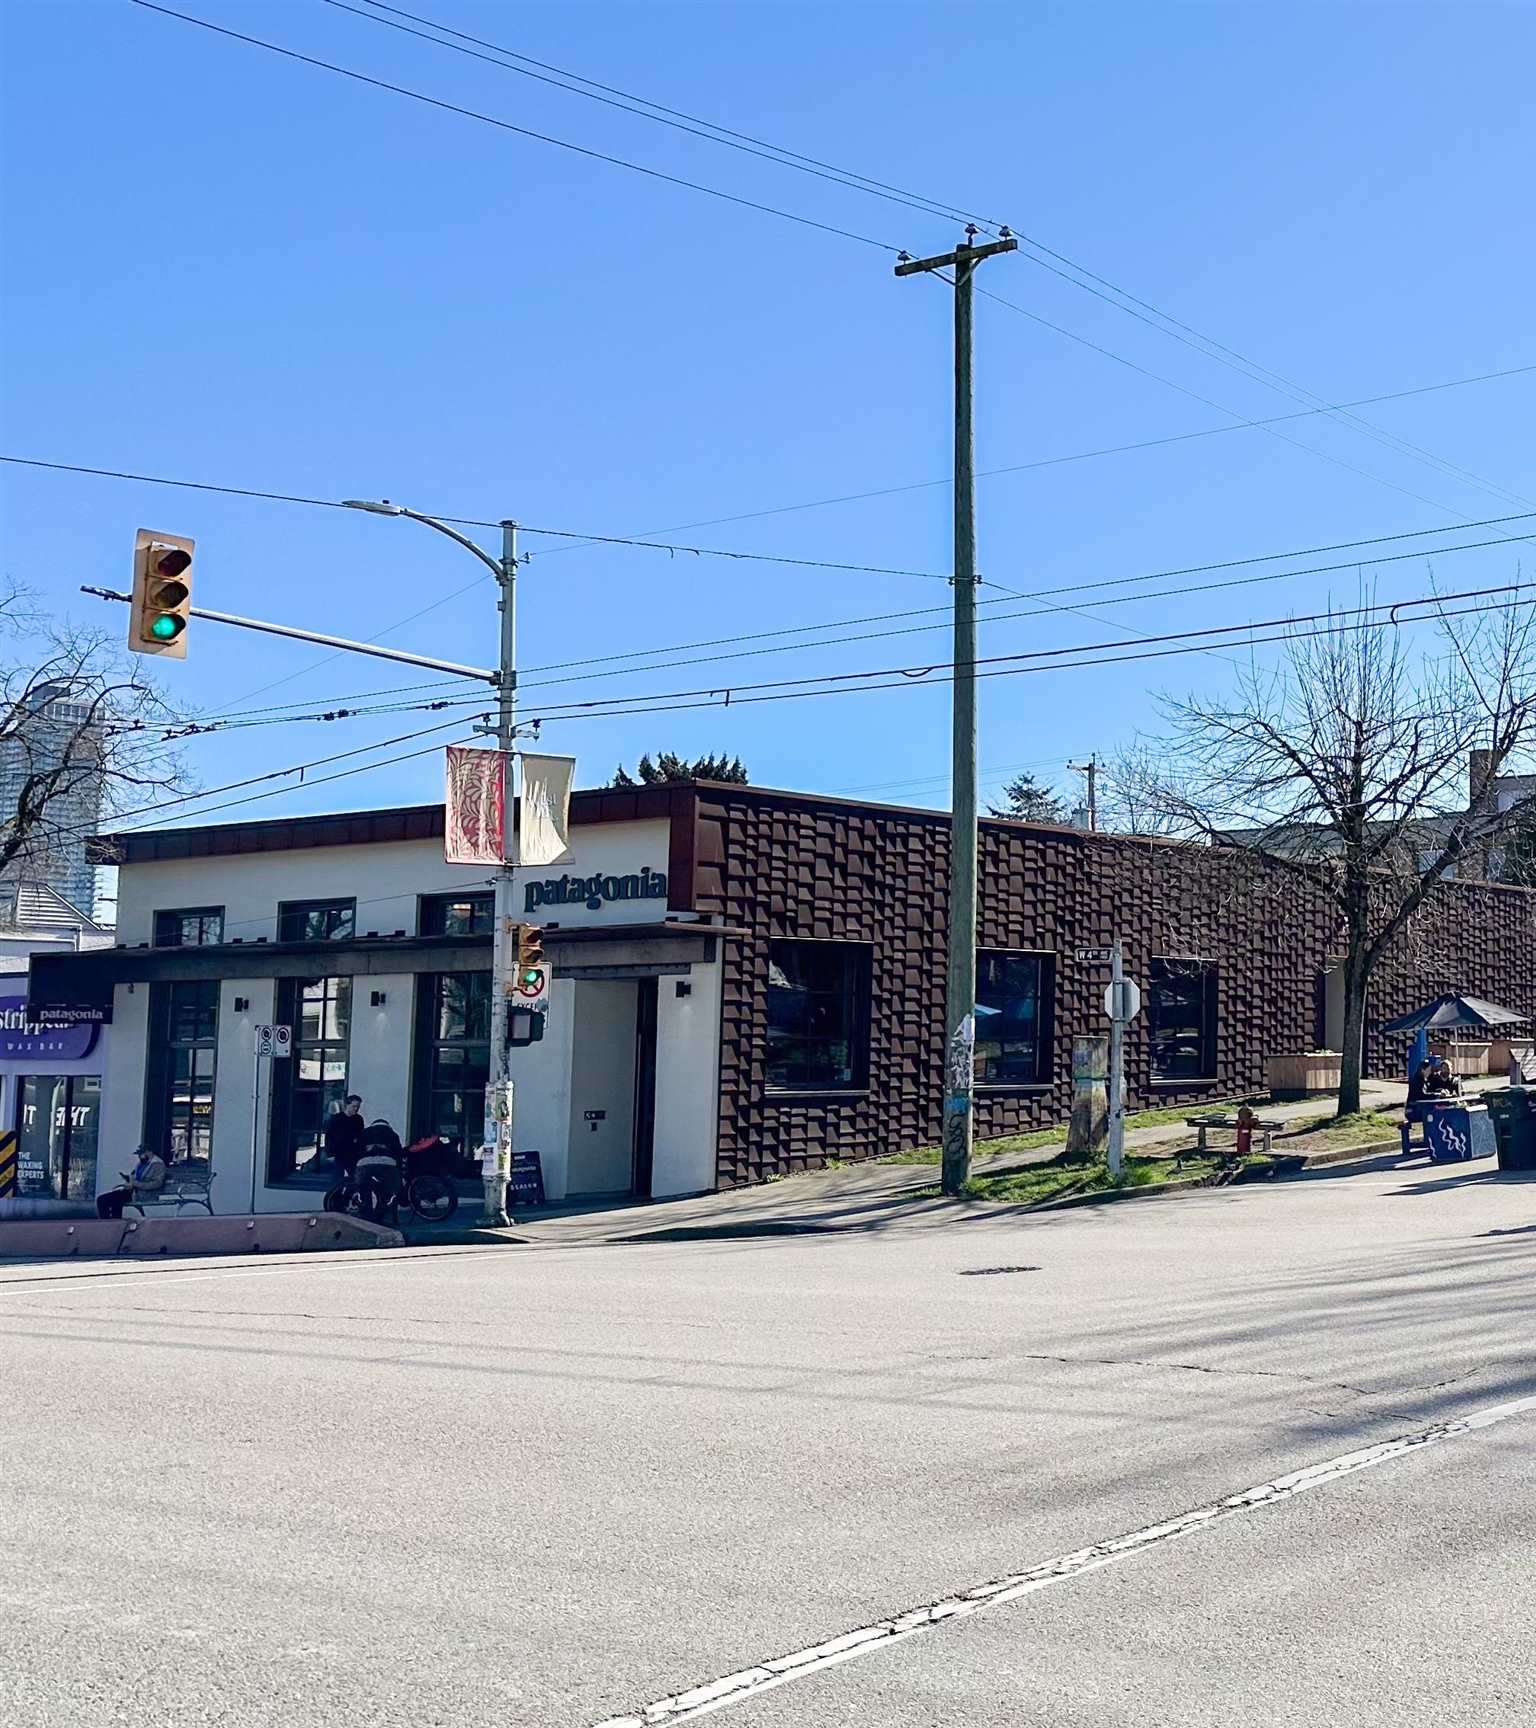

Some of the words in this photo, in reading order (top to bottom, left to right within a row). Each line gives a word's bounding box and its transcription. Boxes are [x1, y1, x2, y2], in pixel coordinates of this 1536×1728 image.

[523, 866, 668, 912] patagonia
[1079, 950, 1086, 960] W
[40, 1008, 104, 1021] patagonia
[18, 1152, 31, 1160] THE
[17, 1161, 43, 1170] WAXING
[17, 1170, 45, 1179] EXPERTS
